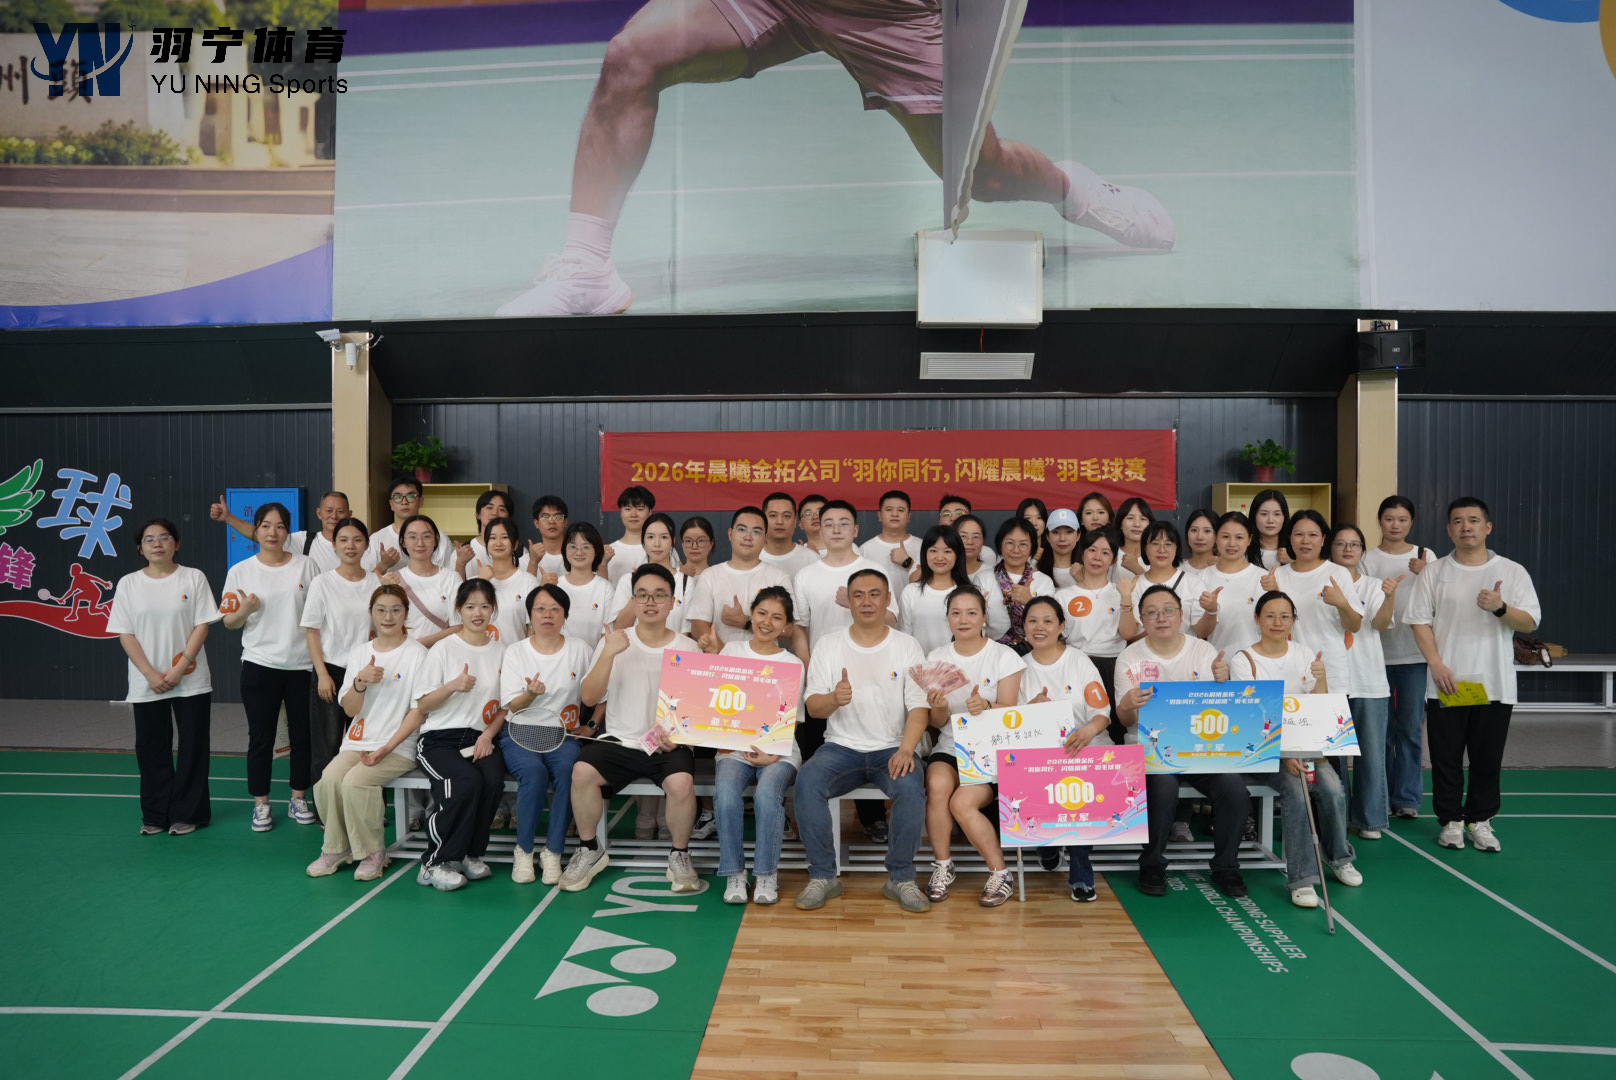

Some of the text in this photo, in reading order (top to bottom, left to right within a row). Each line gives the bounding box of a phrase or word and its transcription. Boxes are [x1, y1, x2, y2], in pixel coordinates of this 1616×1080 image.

[37, 468, 132, 559] 球
[1074, 601, 1086, 612] 2
[709, 688, 747, 711] 700
[1092, 688, 1102, 701] 1
[485, 703, 499, 720] 14
[1285, 698, 1296, 711] 3
[564, 710, 576, 724] 20
[1007, 711, 1017, 728] 1
[1190, 714, 1229, 735] 500
[1044, 782, 1095, 805] 1000
[1194, 882, 1227, 906] WORLD
[1215, 906, 1289, 974] CHAMPIONSHIPS
[1255, 919, 1307, 959] SUPPLIER
